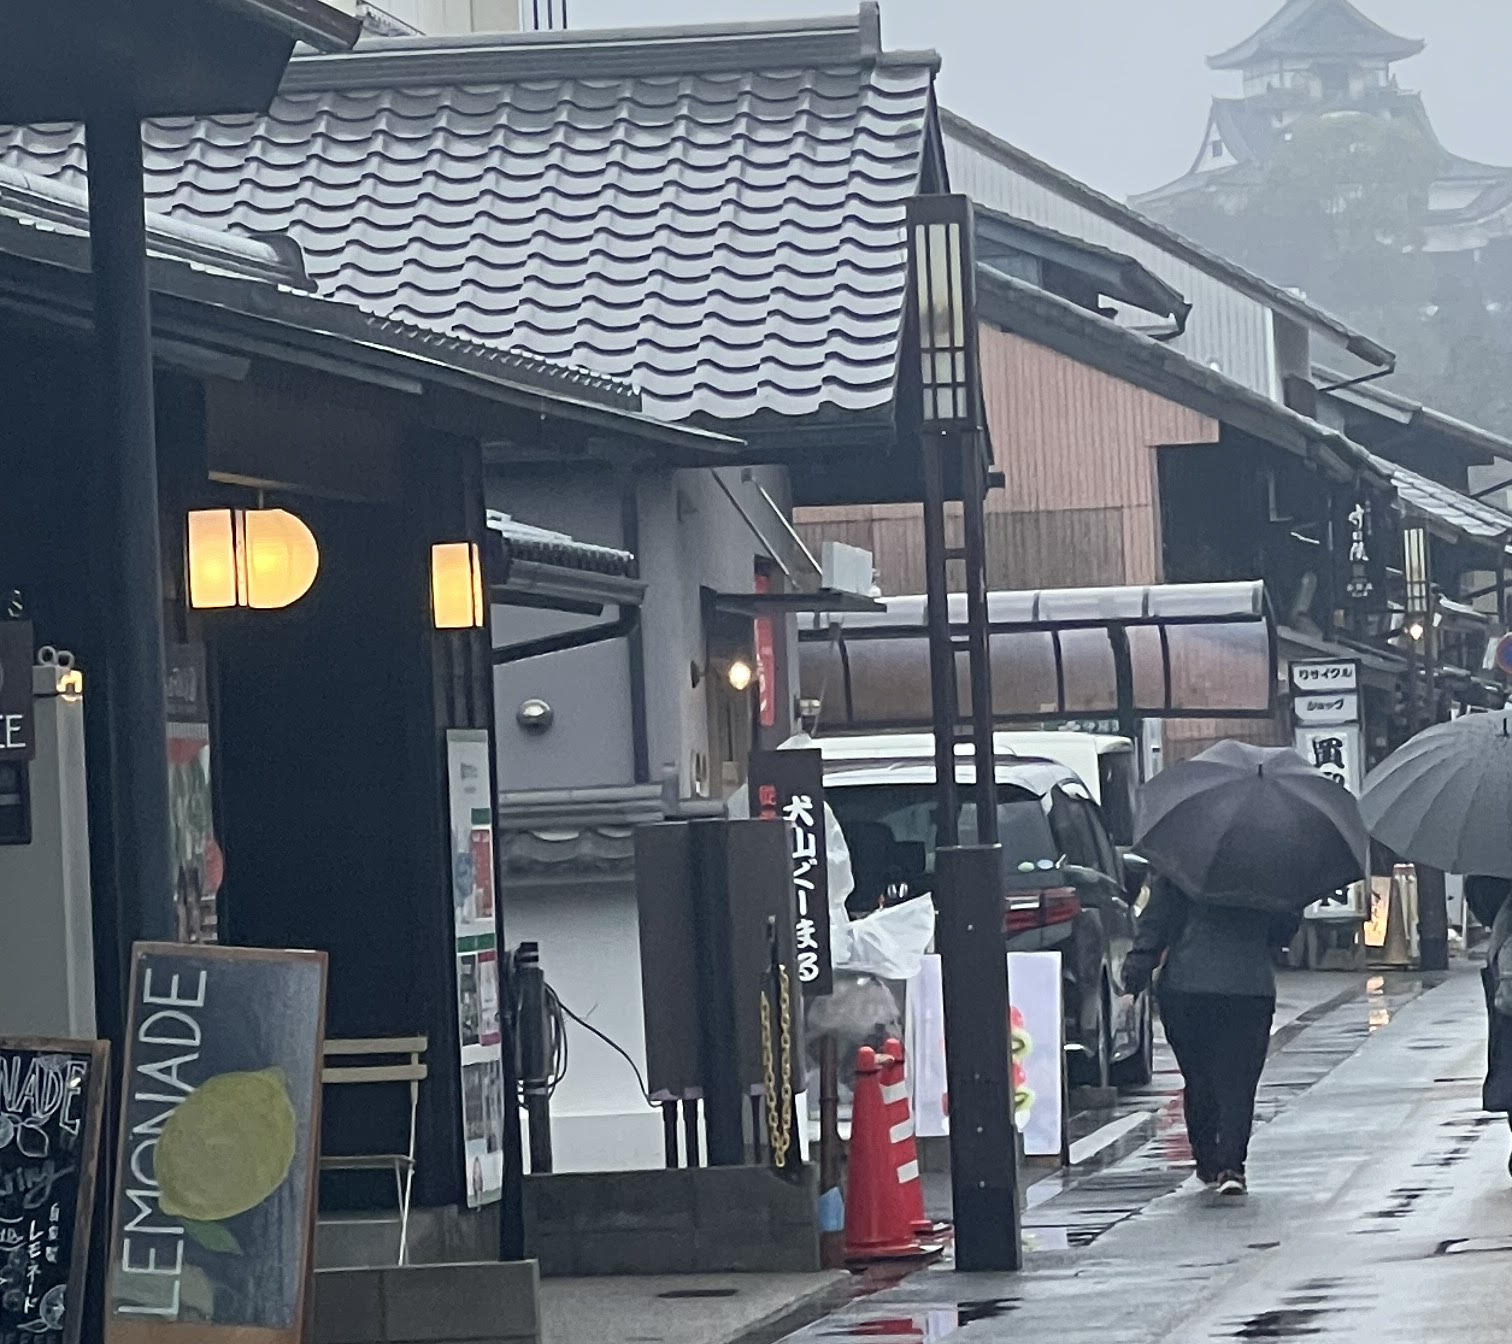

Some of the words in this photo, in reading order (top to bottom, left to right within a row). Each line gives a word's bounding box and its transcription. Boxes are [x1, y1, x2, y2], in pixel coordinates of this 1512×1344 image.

[1299, 667, 1353, 681] リサイクル
[117, 967, 208, 1319] LEMONADE
